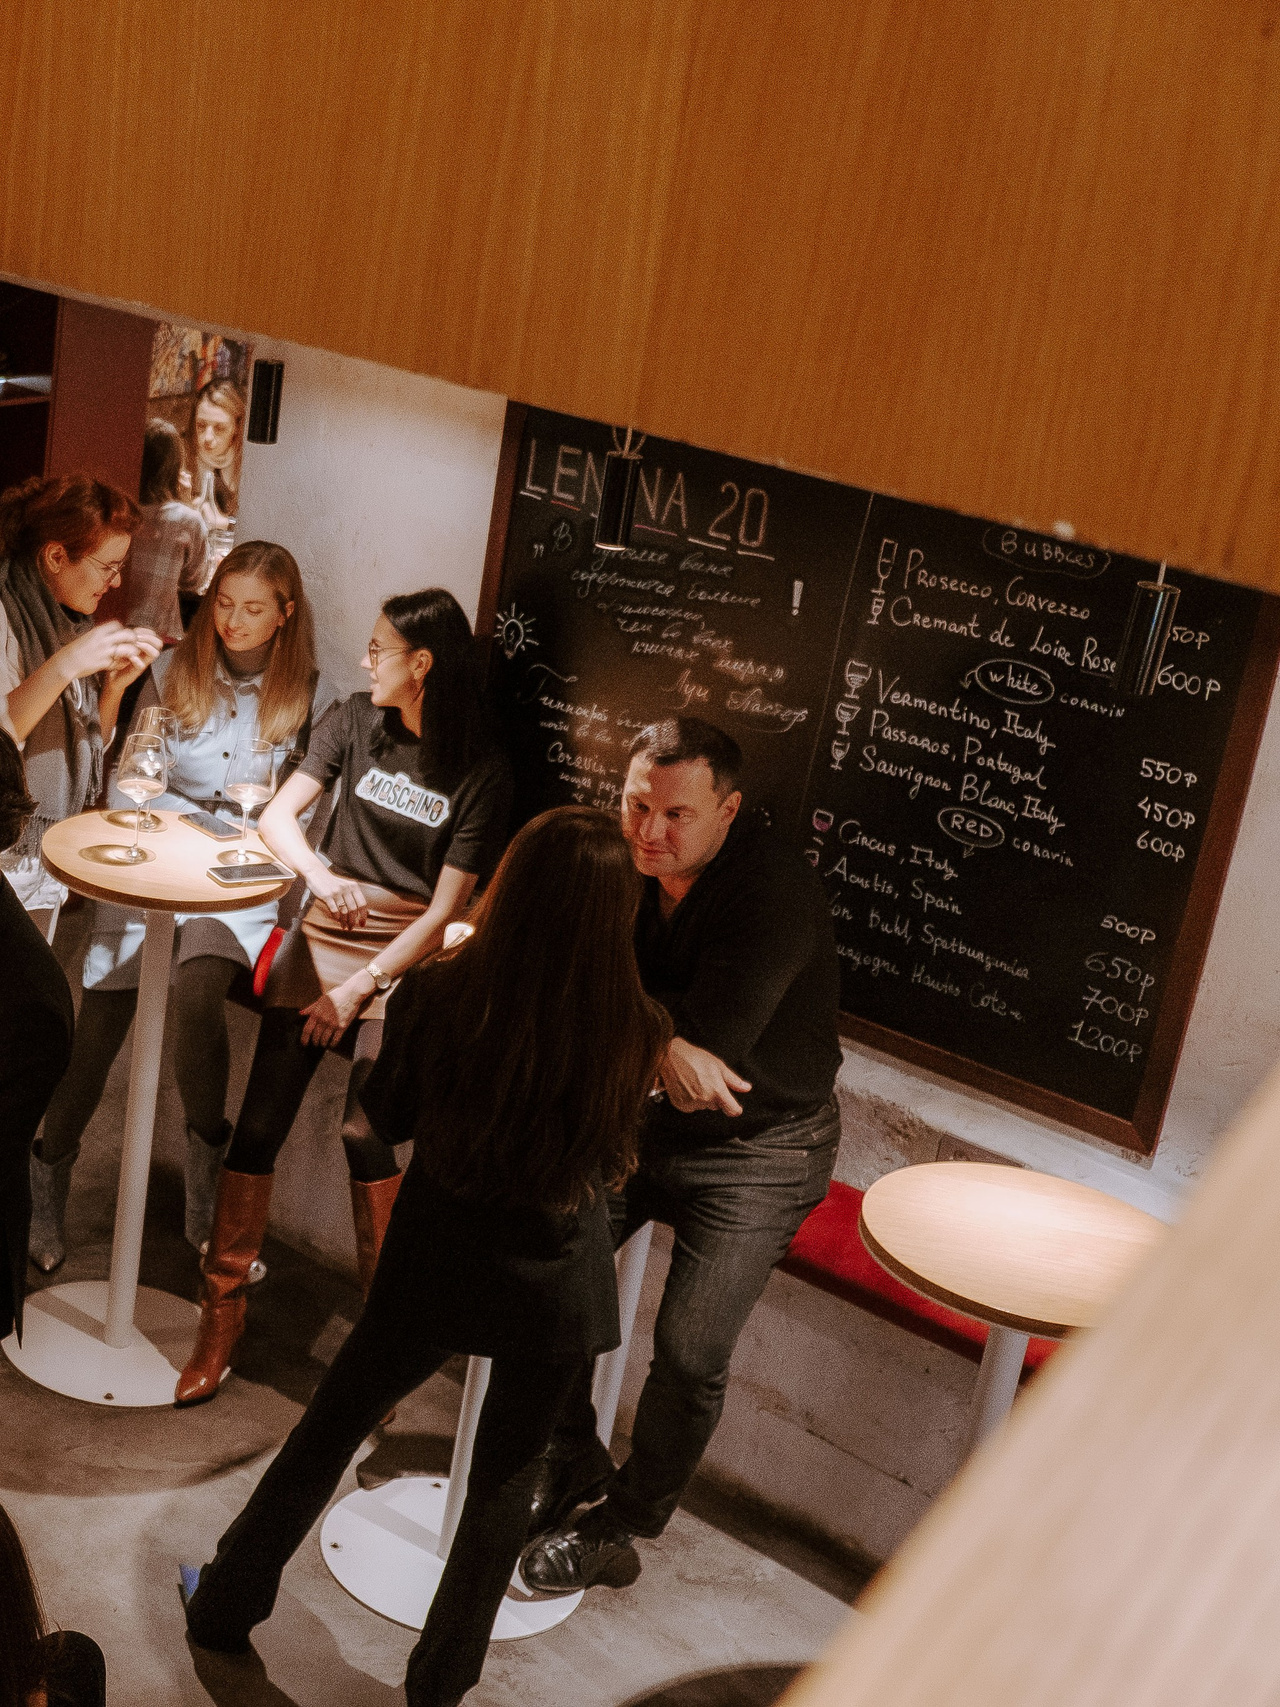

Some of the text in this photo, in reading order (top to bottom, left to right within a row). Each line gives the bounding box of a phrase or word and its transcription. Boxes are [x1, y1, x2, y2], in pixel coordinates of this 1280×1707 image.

[525, 438, 770, 548] LENNA 20
[889, 595, 982, 639] Cremant
[989, 617, 1015, 648] de
[989, 664, 1043, 696] white
[1001, 708, 1057, 756] Italy
[963, 736, 1047, 790] Portugal
[367, 772, 445, 823] MOSCHINO
[859, 744, 952, 800] Sauvignon
[1021, 794, 1066, 836] Italy
[909, 878, 963, 915] Spain
